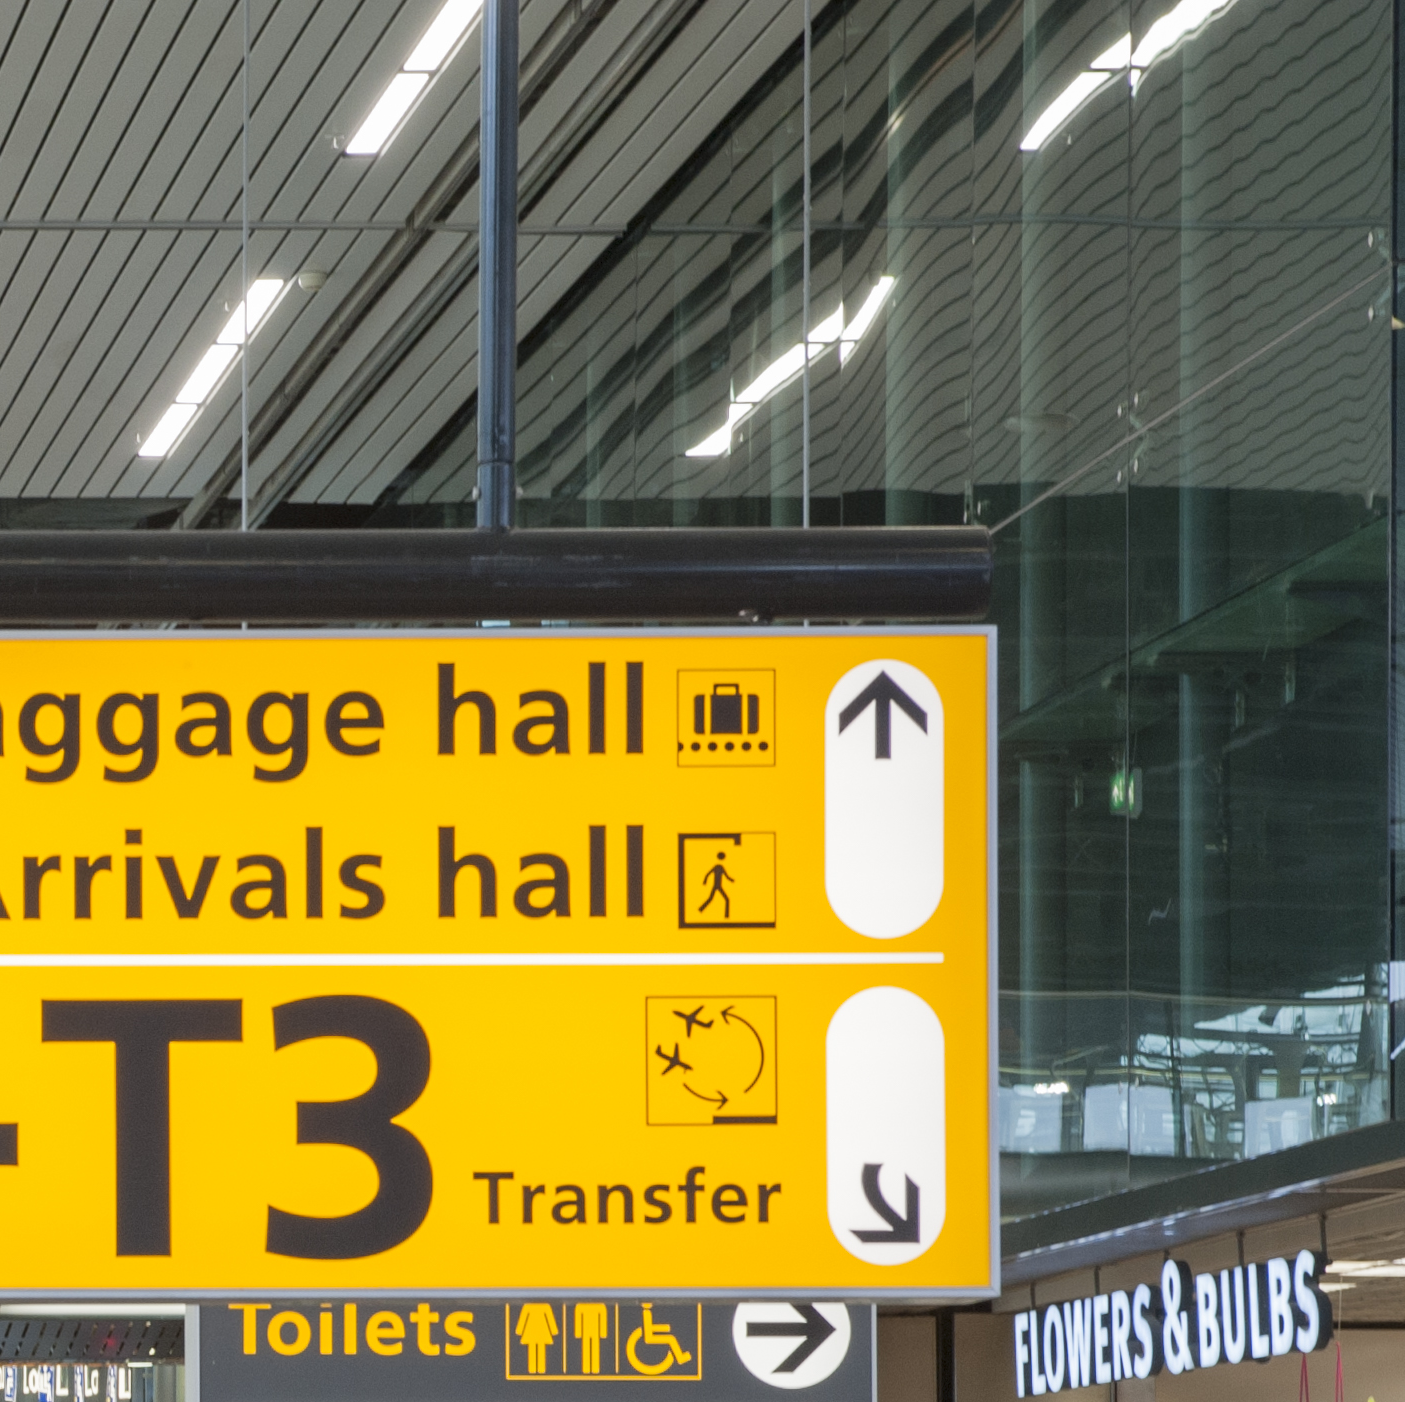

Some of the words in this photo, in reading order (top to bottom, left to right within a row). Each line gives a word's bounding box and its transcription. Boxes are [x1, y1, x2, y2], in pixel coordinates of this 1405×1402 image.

[437, 661, 644, 756] hall
[438, 824, 644, 918] hall
[473, 1166, 782, 1226] Transfer
[228, 1303, 478, 1356] Toilets
[1014, 1282, 1153, 1398] FLOWERS
[1161, 1258, 1195, 1375] &
[1195, 1248, 1320, 1368] BULBS
